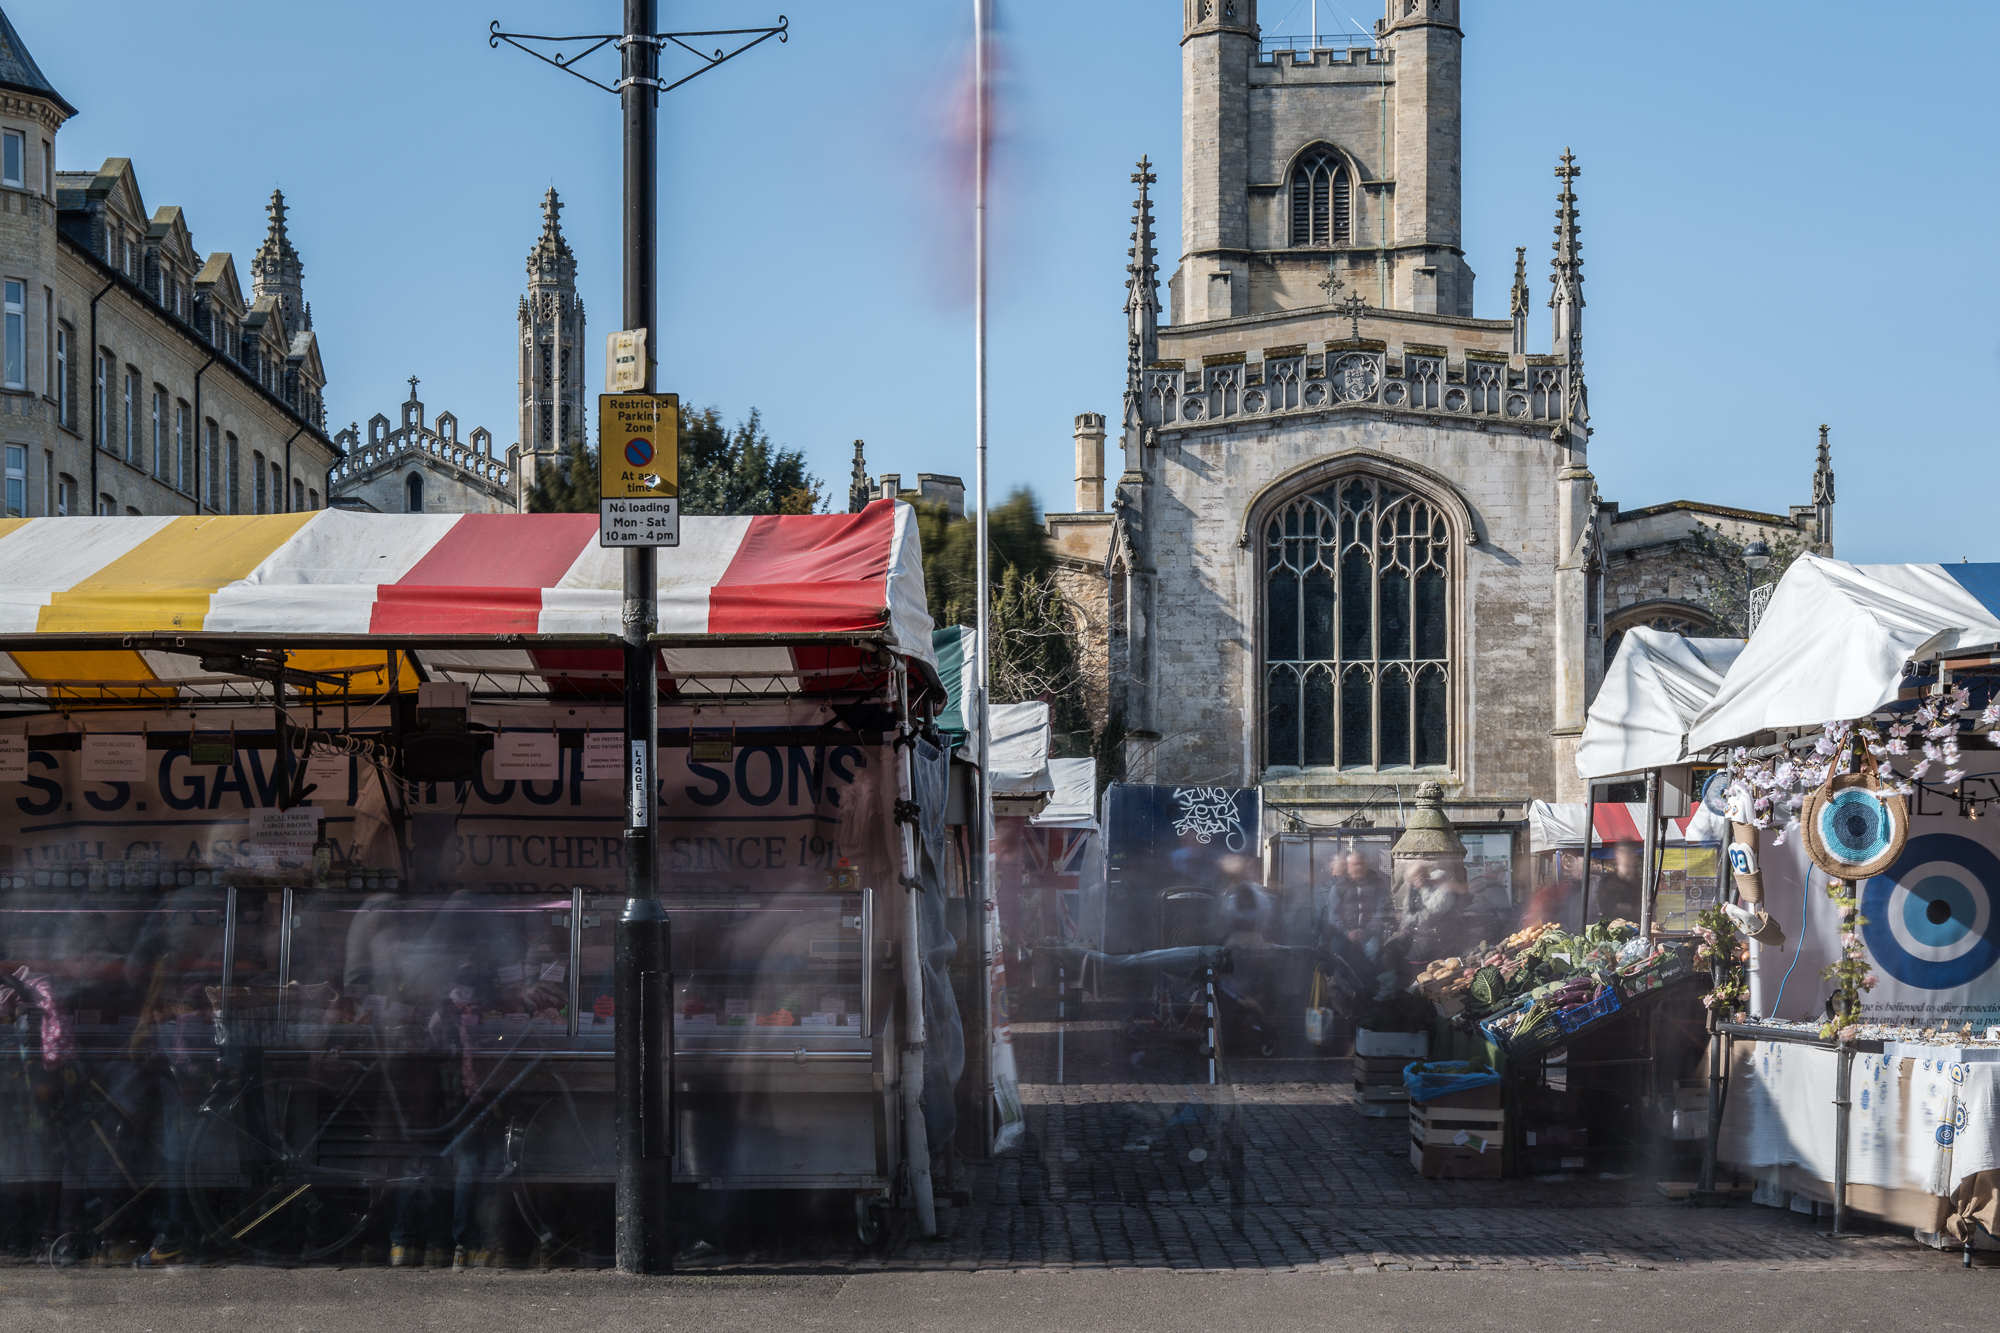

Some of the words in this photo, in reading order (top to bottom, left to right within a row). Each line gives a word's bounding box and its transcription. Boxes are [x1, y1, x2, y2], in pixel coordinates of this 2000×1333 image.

[610, 399, 669, 409] Restricted
[618, 411, 660, 421] Parking
[625, 423, 653, 433] Zone
[621, 471, 634, 481] At
[627, 483, 652, 492] time
[610, 503, 626, 513] No
[629, 502, 670, 514] loading
[613, 517, 637, 527] Mon
[646, 517, 666, 527] Sat
[606, 531, 619, 541] 10
[621, 533, 637, 541] am
[646, 531, 654, 540] 4
[656, 533, 674, 542] pm
[685, 746, 867, 807] SONS
[670, 835, 787, 871] SINCE
[798, 834, 843, 871] 191
[1875, 1002, 1883, 1012] is
[1885, 1002, 1924, 1012] believed
[1926, 1003, 1935, 1012] to
[1937, 1003, 1958, 1015] offer
